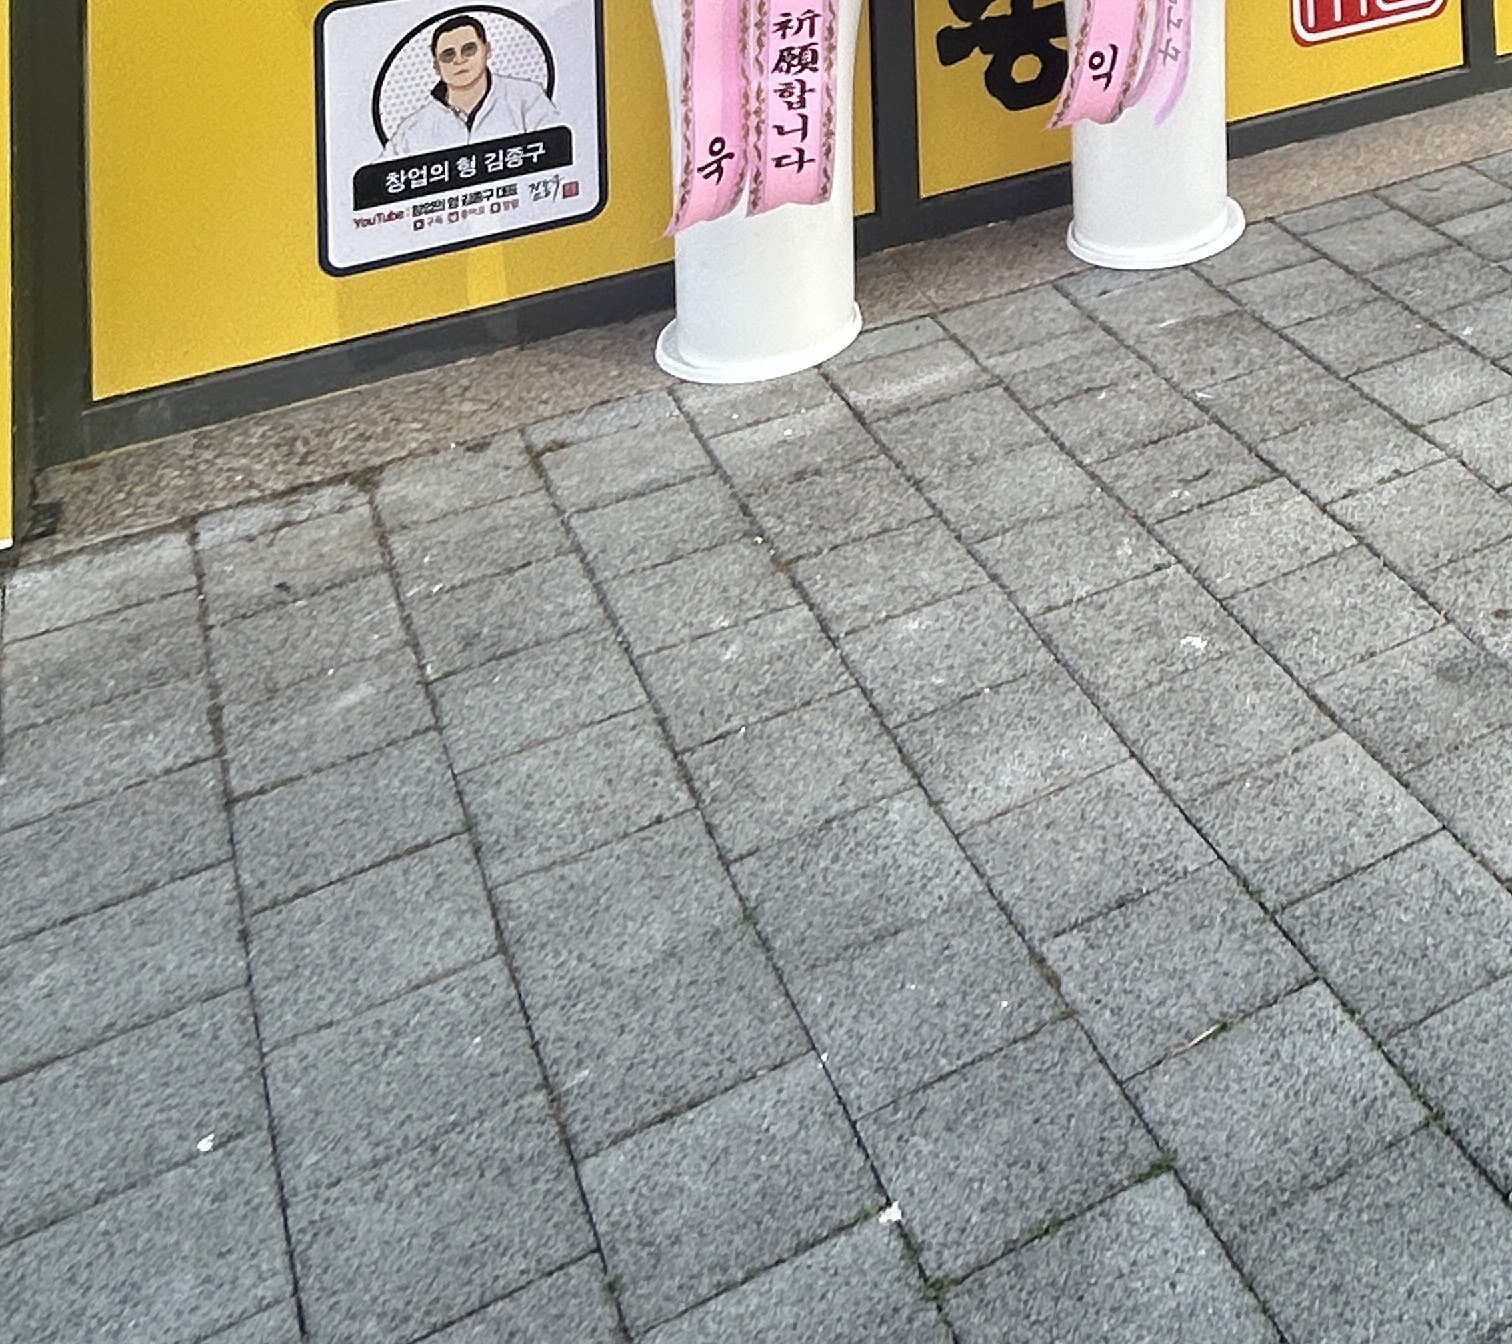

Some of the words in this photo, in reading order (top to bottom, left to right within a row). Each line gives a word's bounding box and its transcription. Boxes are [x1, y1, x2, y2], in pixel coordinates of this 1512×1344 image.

[769, 9, 824, 176] 祈願합니다
[385, 159, 451, 194] 창업의
[456, 156, 478, 179] 형
[484, 141, 547, 172] 김종구
[352, 207, 405, 230] YouTube
